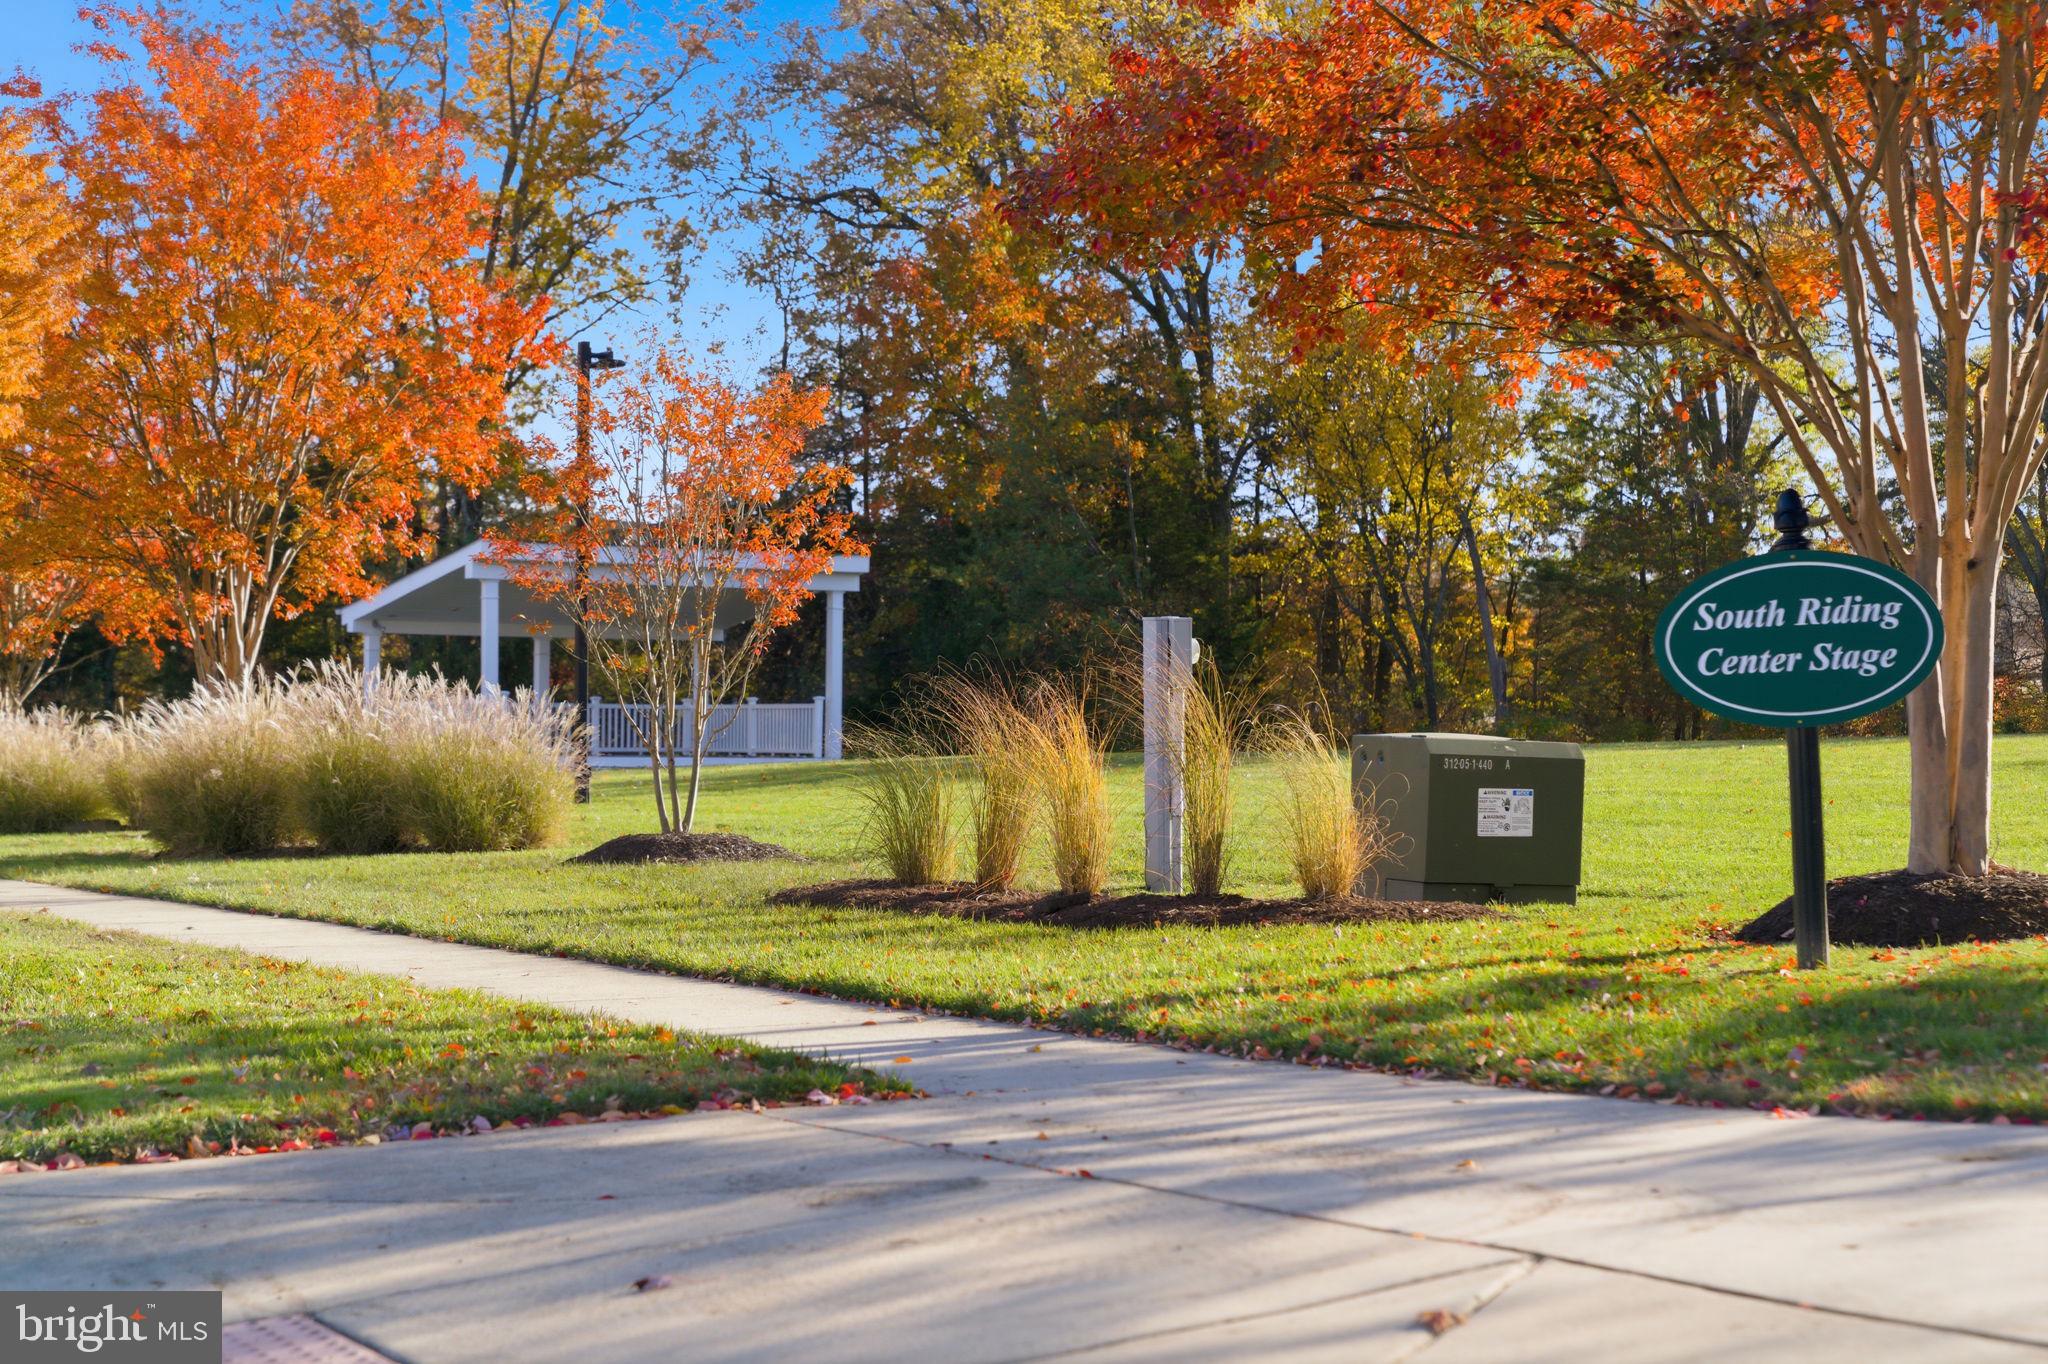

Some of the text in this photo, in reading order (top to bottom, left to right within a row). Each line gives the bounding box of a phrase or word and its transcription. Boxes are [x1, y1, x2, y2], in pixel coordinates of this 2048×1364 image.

[1693, 595, 1903, 631] South Riding
[1697, 642, 1897, 677] Center Stage
[1505, 760, 1511, 770] A
